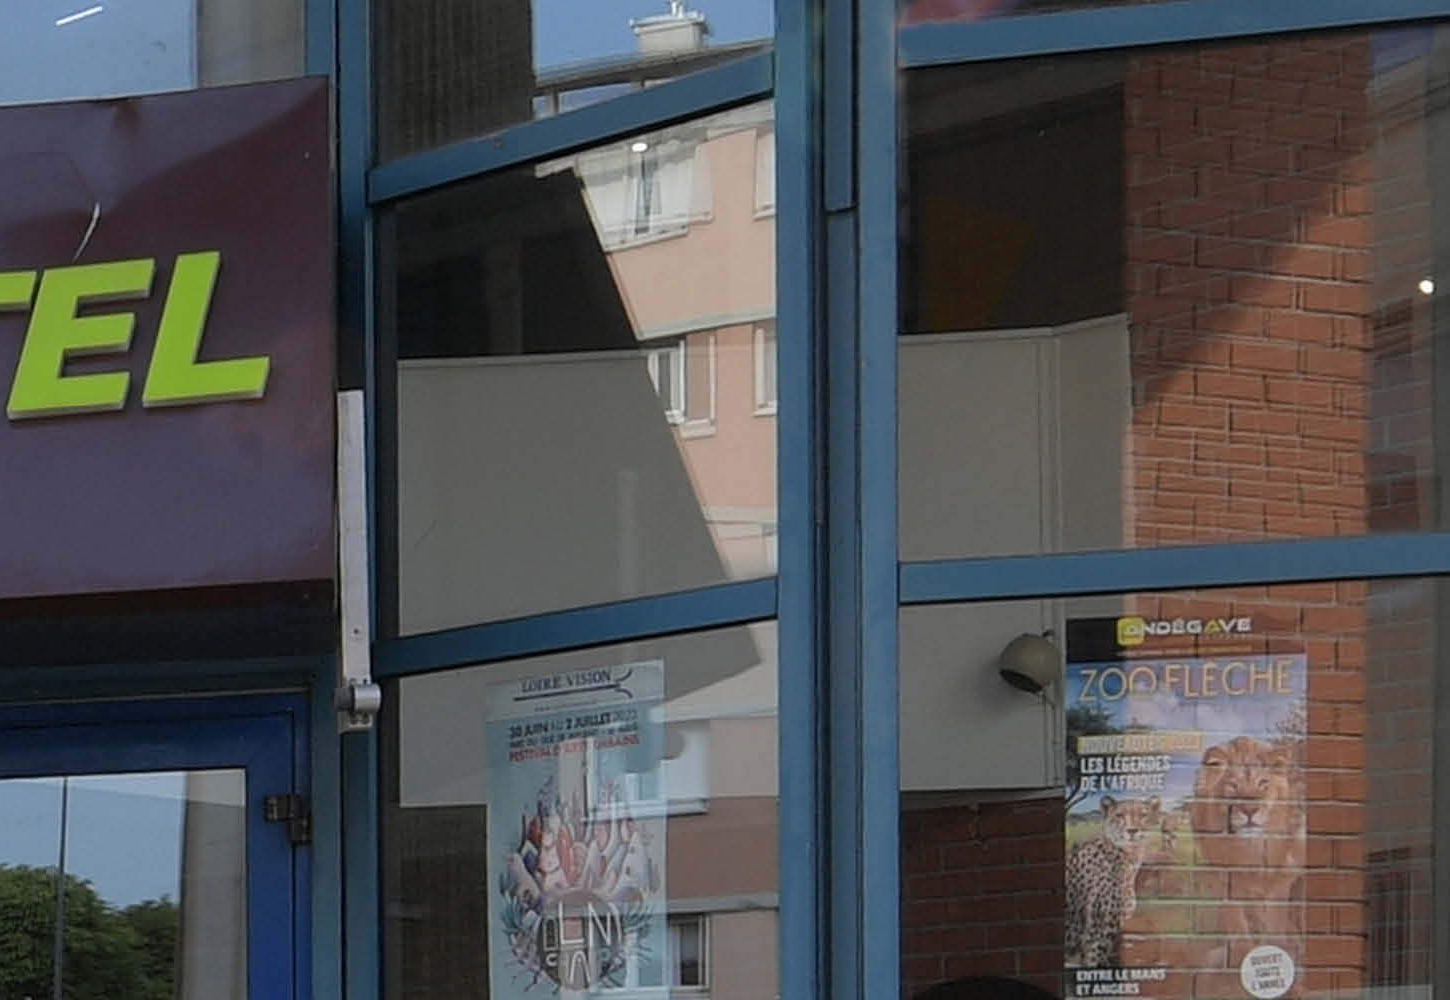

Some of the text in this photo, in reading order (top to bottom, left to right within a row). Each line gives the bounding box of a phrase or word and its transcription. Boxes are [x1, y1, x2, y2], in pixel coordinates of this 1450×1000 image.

[1079, 666, 1157, 702] ZOO
[1081, 753, 1171, 773] LES LÉGENDES
[1080, 773, 1166, 792] DE L'AFRIQUE
